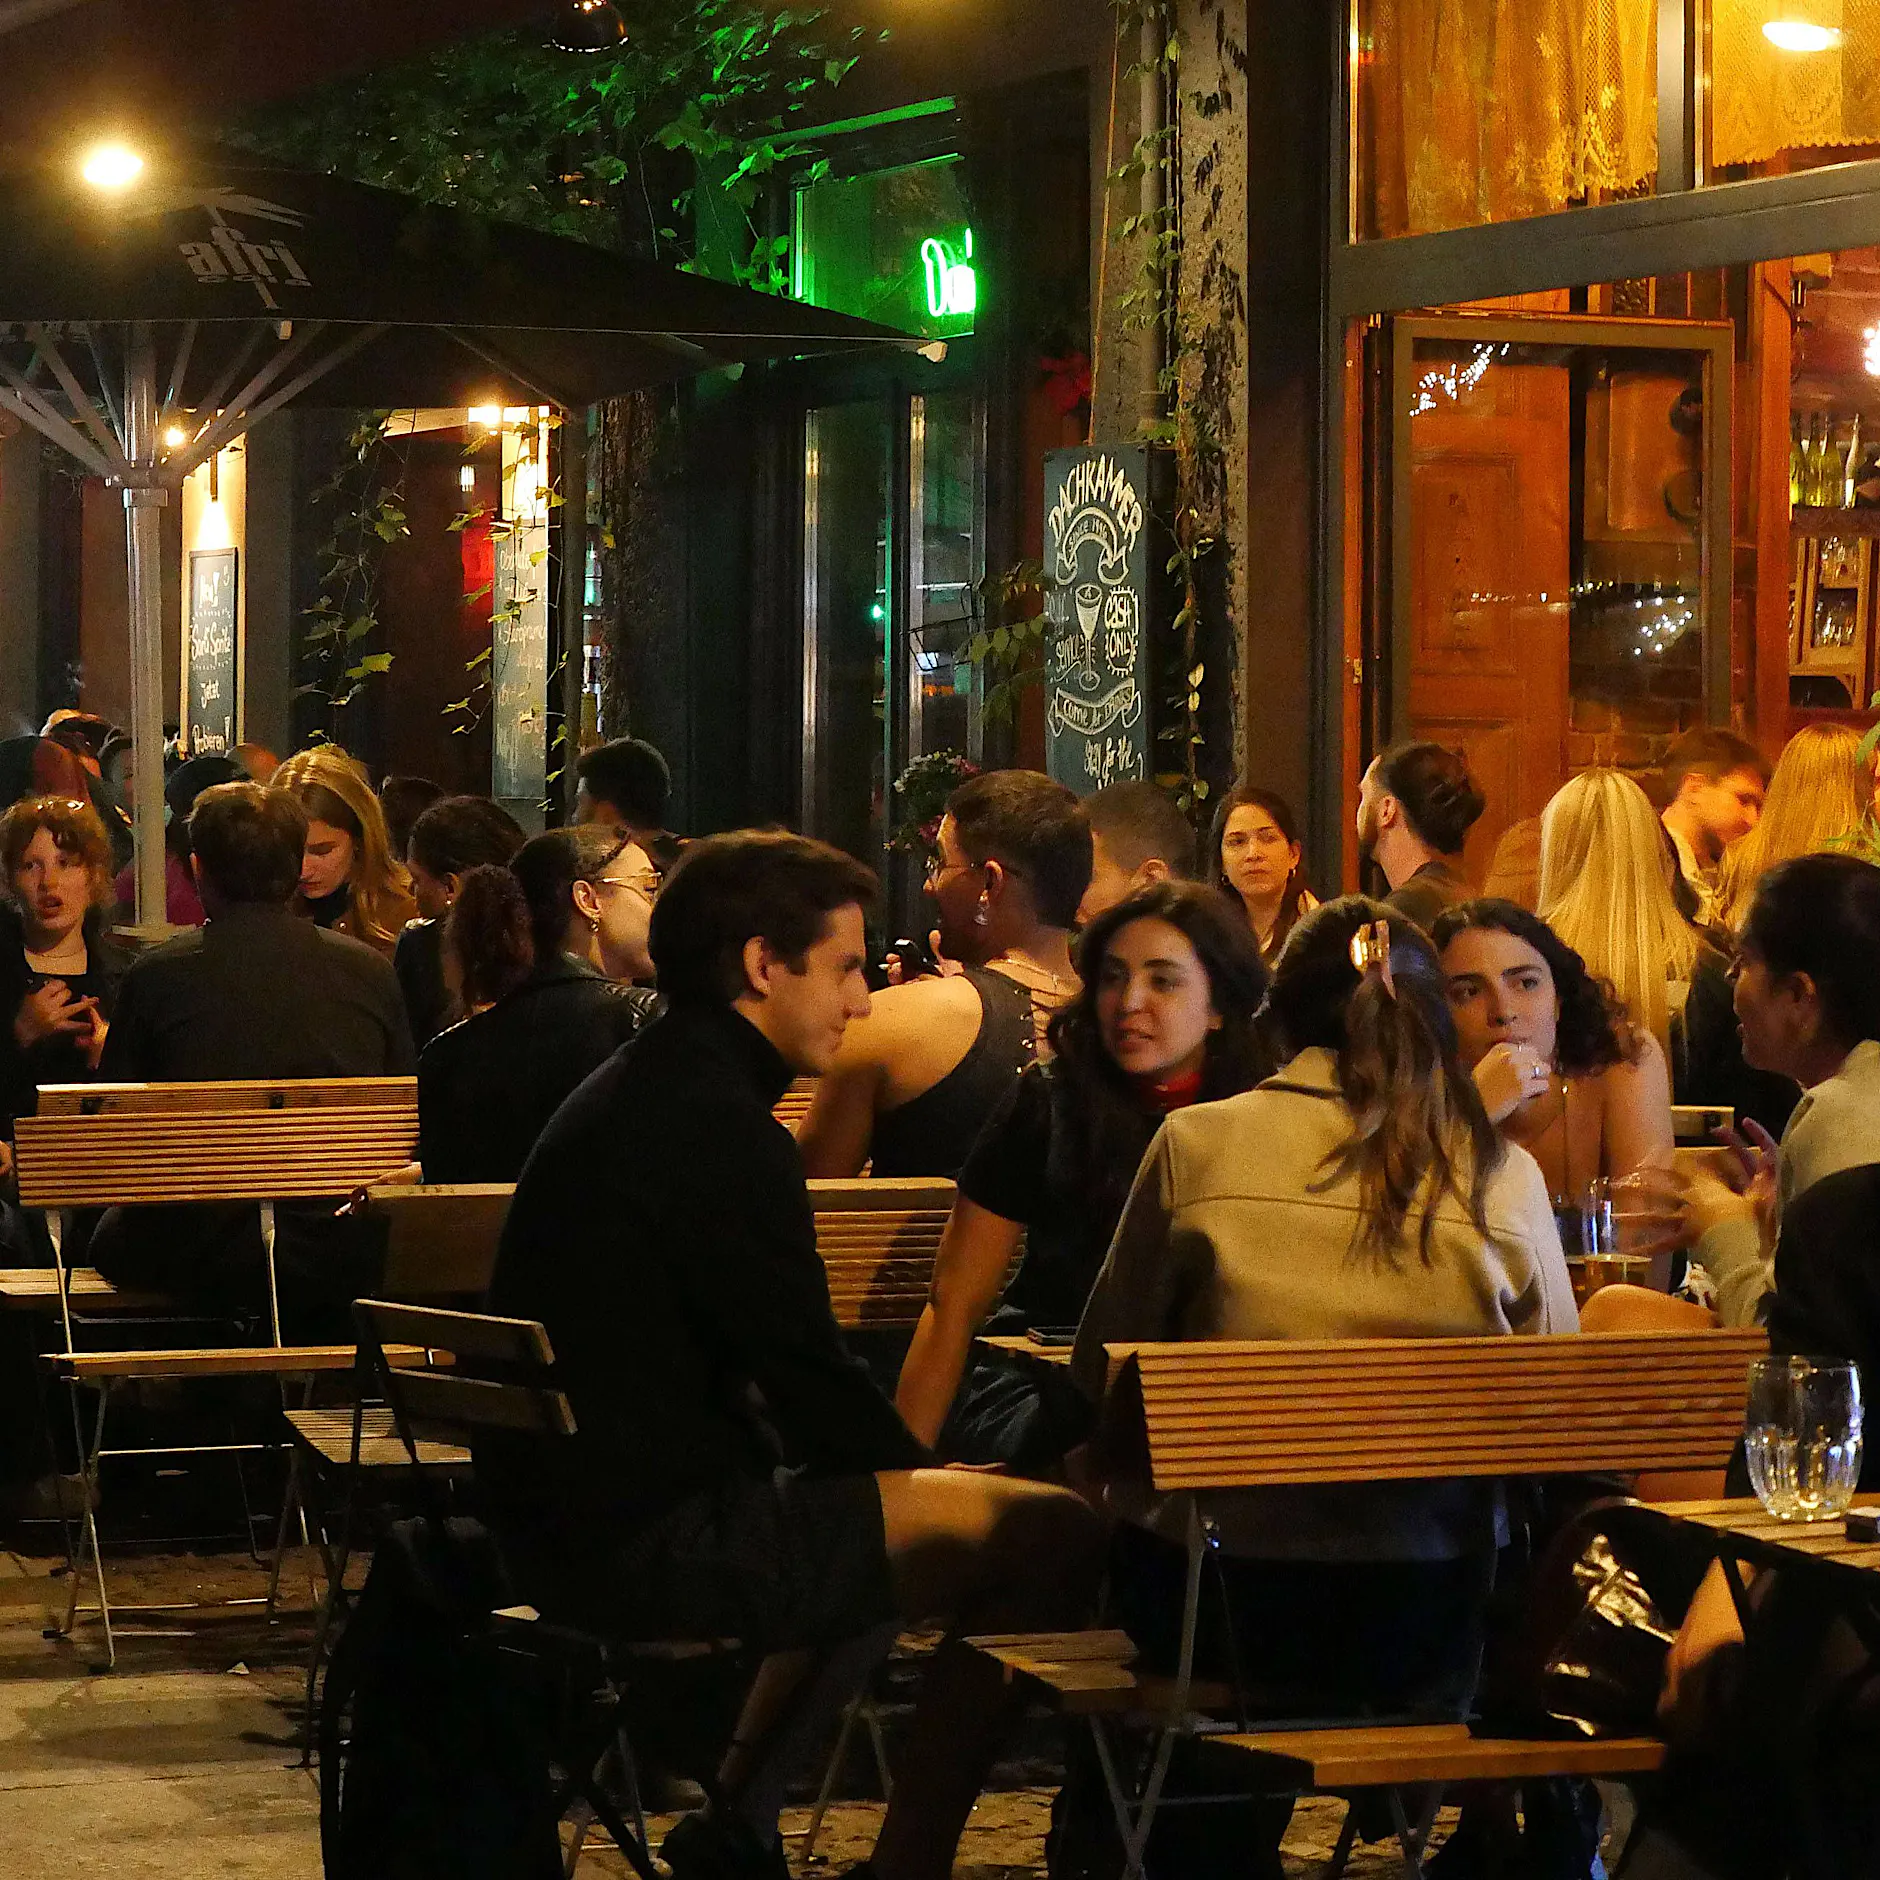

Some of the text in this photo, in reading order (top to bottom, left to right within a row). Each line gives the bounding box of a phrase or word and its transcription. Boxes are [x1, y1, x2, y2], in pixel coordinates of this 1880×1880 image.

[179, 225, 309, 281] afri
[1048, 453, 1143, 552] DACHKAMMER
[1109, 629, 1135, 658] ONLY
